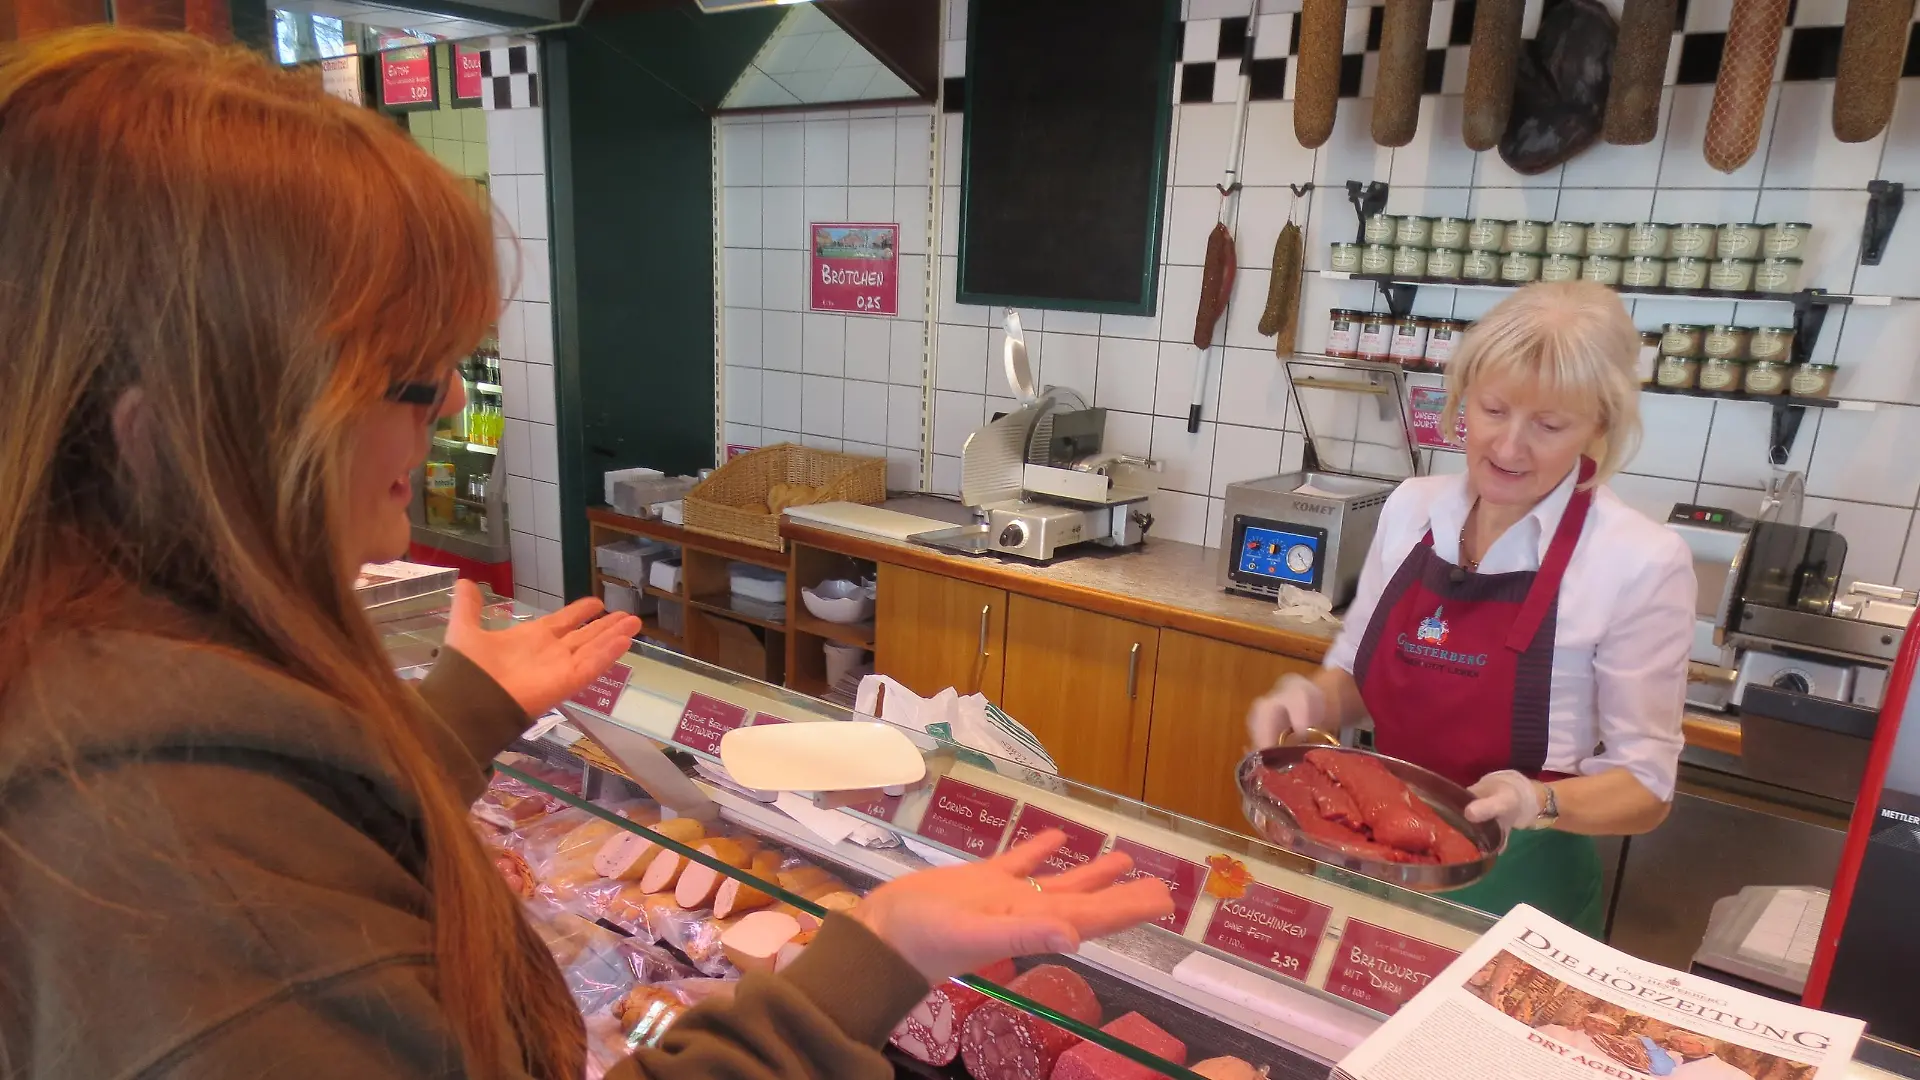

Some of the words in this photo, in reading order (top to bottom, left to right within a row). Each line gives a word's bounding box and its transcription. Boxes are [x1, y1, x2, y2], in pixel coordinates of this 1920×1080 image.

[821, 264, 885, 287] BRÖTCHEN
[856, 295, 881, 311] 0,25
[1292, 500, 1336, 516] KOMET
[708, 742, 721, 755] 0,8
[938, 796, 973, 818] CORNED
[979, 808, 1007, 828] BEEF
[1881, 808, 1920, 825] METTLER
[1056, 846, 1090, 864] ERLINER
[1220, 900, 1307, 938] KOCHSCHINKEN
[1223, 920, 1243, 933] OHNE
[1247, 926, 1272, 944] FETT
[1270, 951, 1300, 971] 2,39
[1350, 945, 1431, 986] BRATWURST
[1343, 967, 1363, 981] MIT
[1369, 970, 1403, 995] DARM
[1517, 926, 1580, 969] DIE
[1585, 964, 1832, 1050] HOFZEITUNG
[1526, 1032, 1570, 1056] DRY
[1571, 1054, 1634, 1080] AGED
